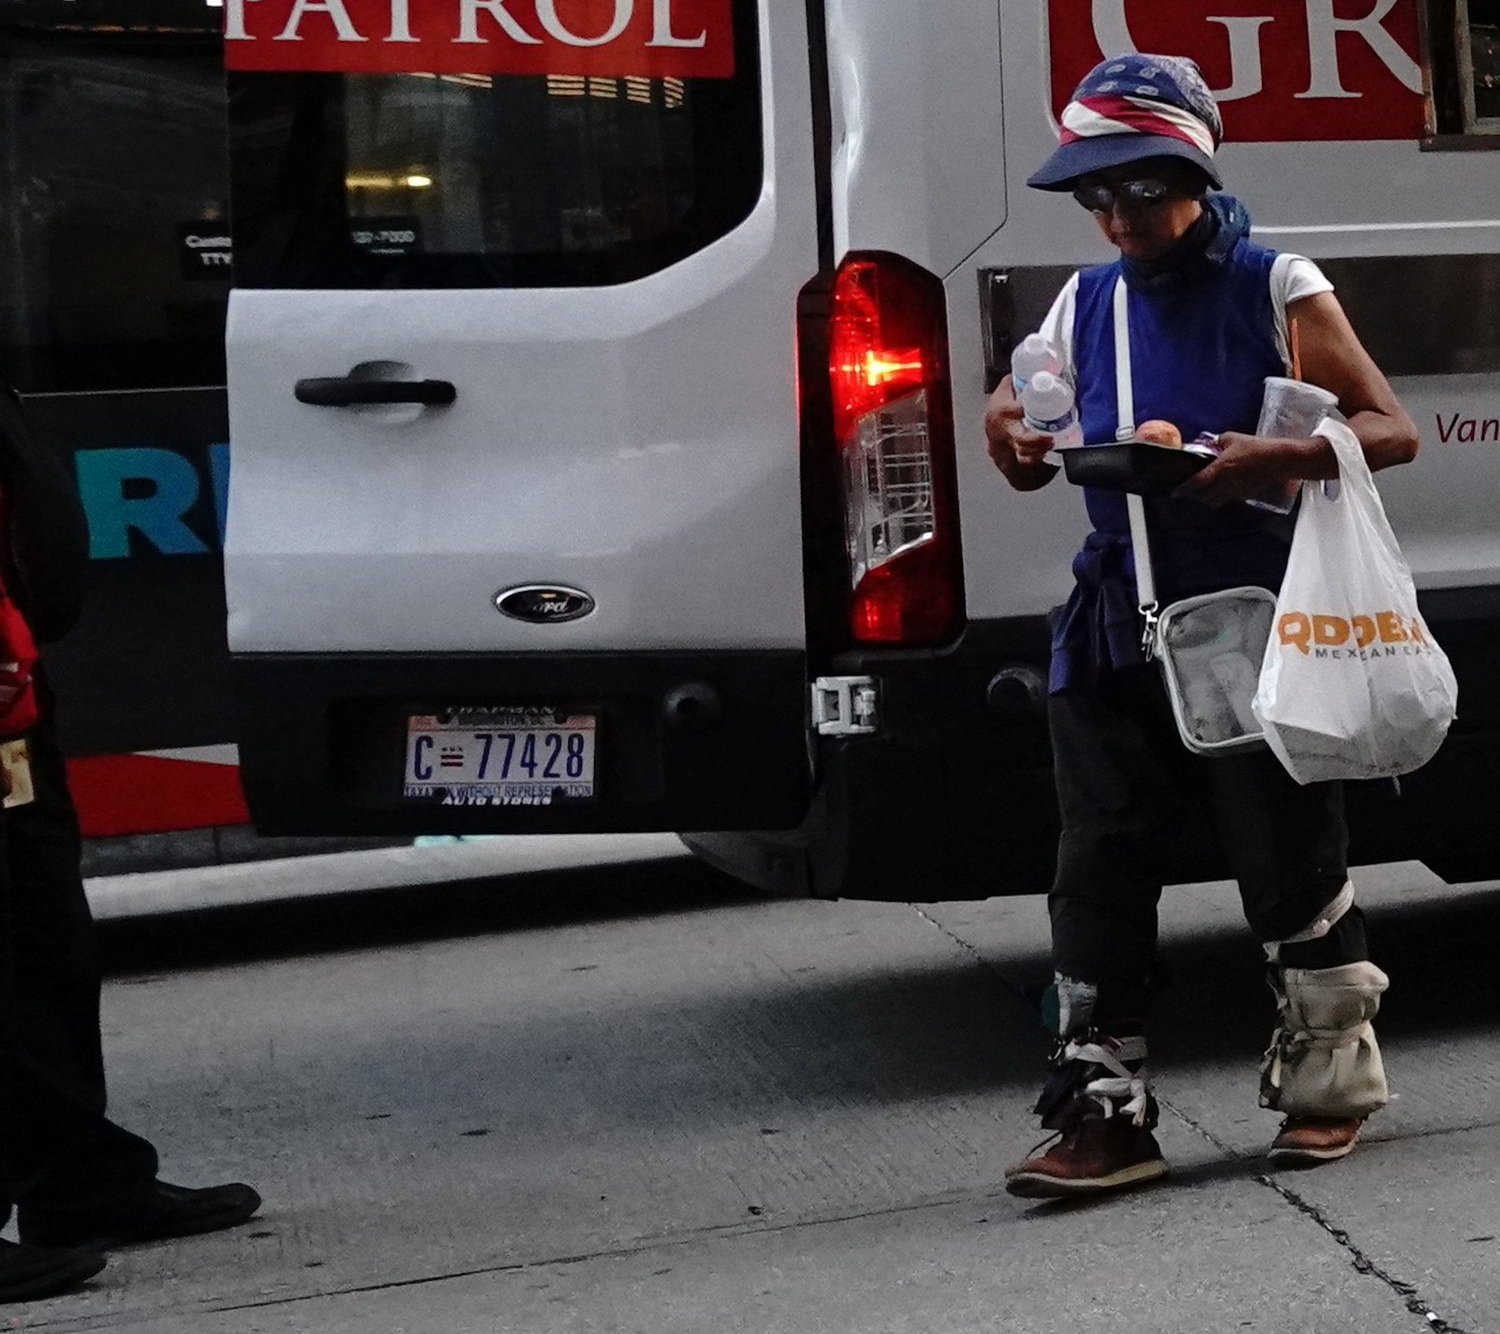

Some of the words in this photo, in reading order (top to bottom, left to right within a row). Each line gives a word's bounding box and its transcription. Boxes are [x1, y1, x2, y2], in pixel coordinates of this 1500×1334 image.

[1436, 413, 1500, 444] Van
[1315, 646, 1397, 661] MEXCAN
[413, 734, 434, 781] C
[473, 732, 585, 780] 77428
